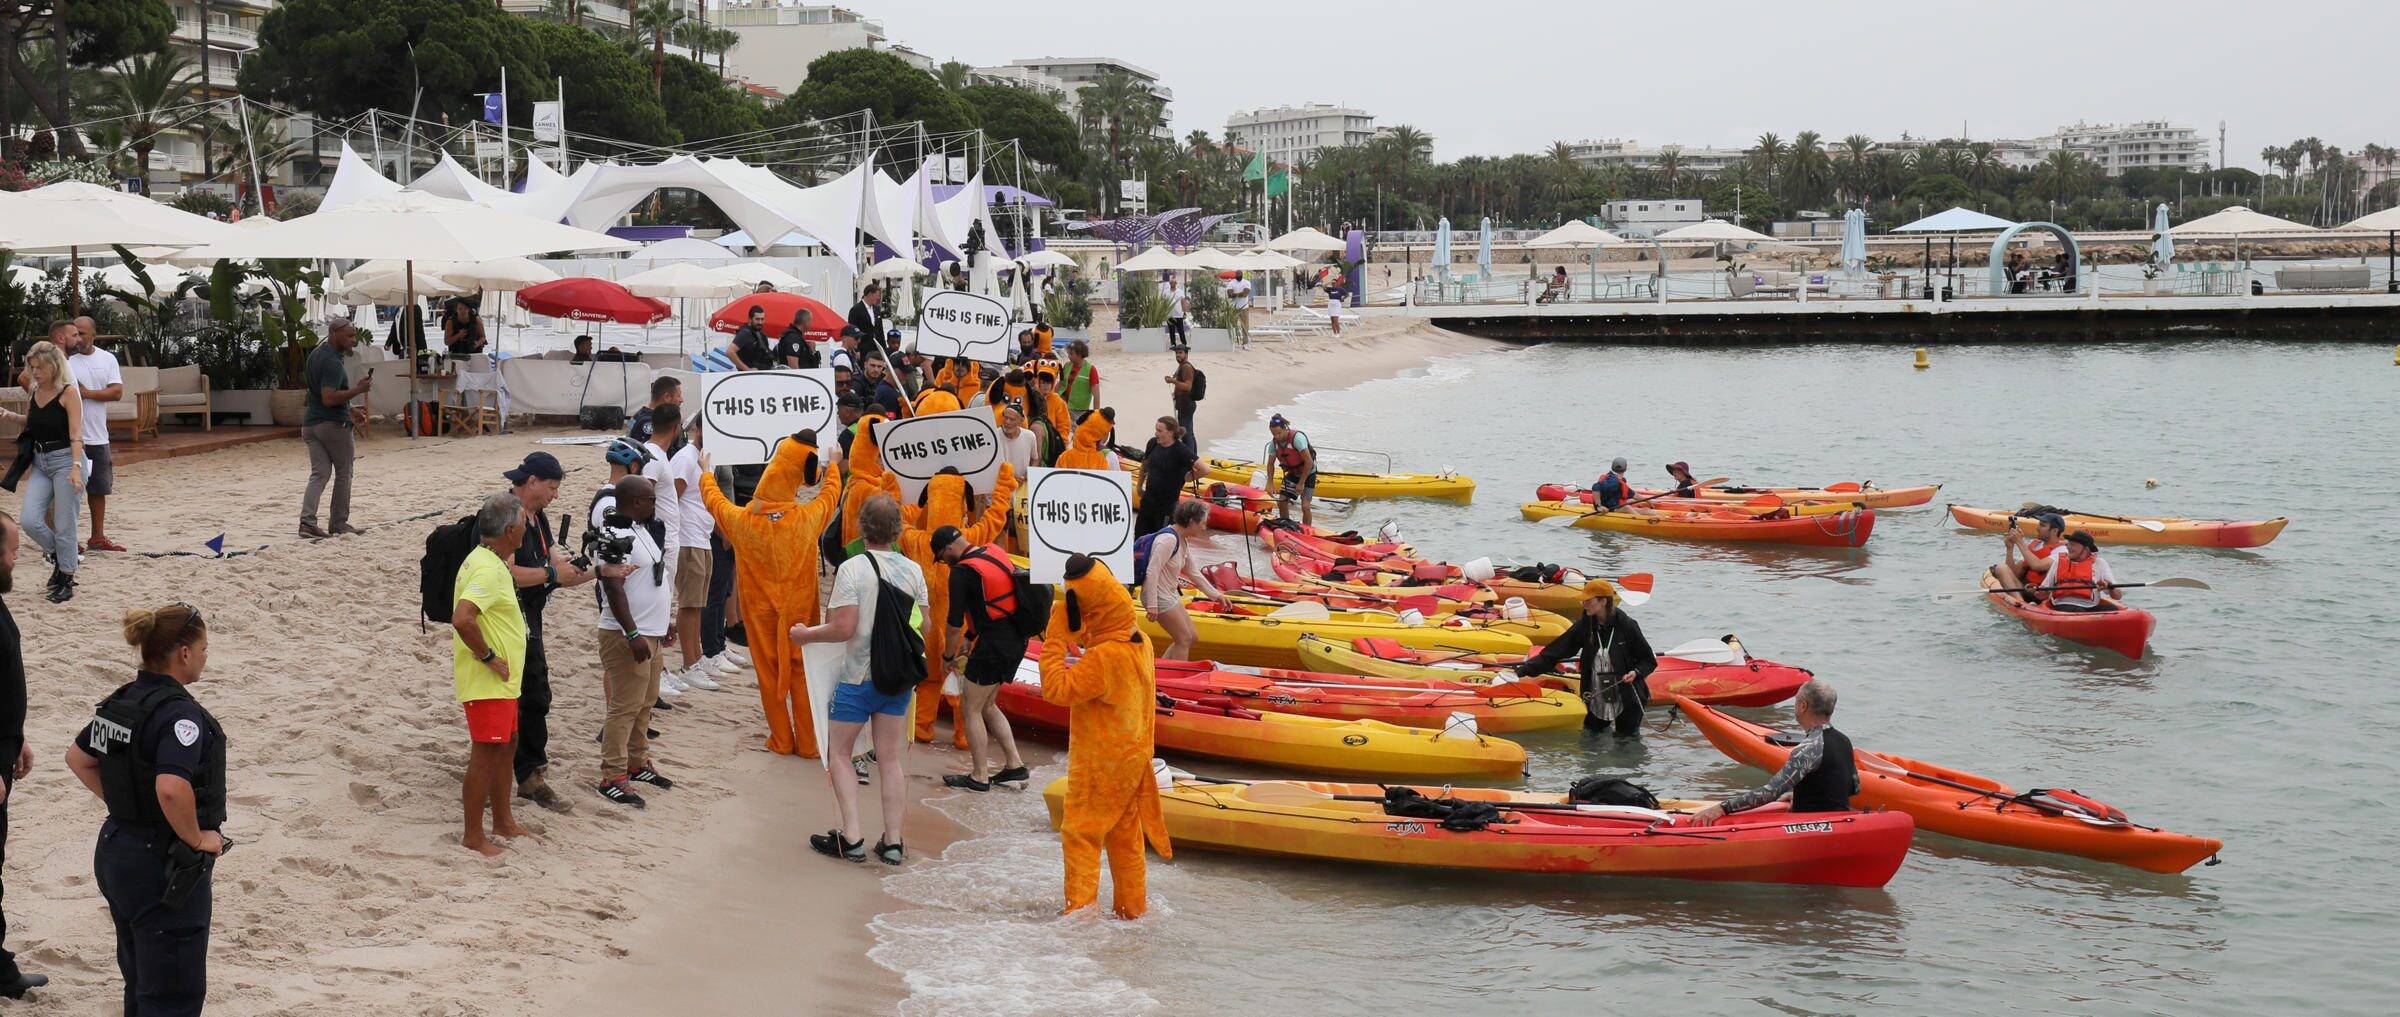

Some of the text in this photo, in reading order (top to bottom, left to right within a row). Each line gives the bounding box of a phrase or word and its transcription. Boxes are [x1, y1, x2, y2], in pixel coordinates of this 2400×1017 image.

[928, 307, 1004, 327] THIS IS FINE.
[712, 395, 826, 416] THIS IS FINE.
[889, 432, 991, 461] THIS IS FINE.
[1037, 500, 1125, 525] THIS IS FINE.
[1386, 819, 1426, 836] RTM
